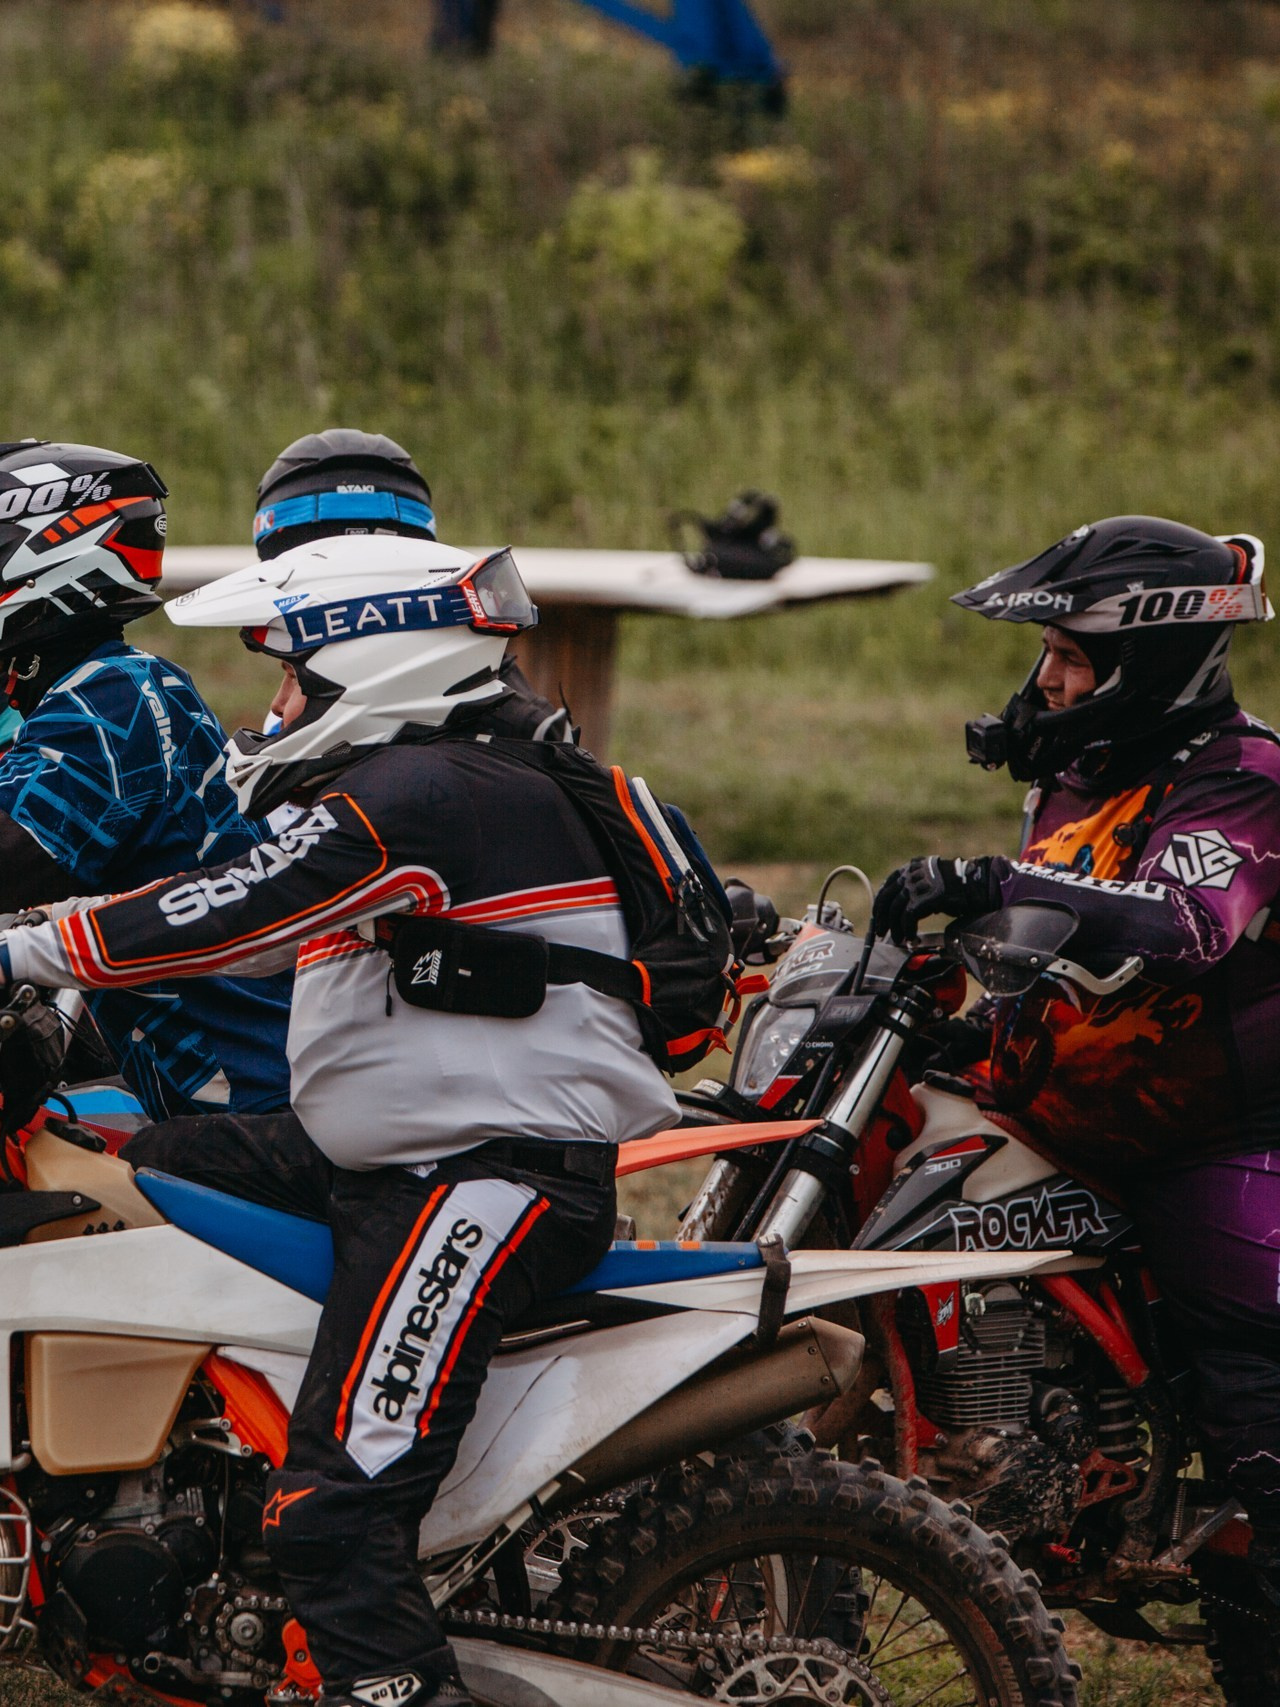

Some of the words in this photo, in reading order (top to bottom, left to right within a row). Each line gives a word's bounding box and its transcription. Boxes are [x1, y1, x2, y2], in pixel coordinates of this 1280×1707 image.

[296, 594, 443, 643] LEATT
[463, 586, 486, 619] LEATT
[983, 591, 1074, 612] AIROH
[1119, 584, 1244, 626] 100%
[924, 1158, 962, 1176] 300
[948, 1187, 1109, 1252] ROCKER
[370, 1218, 484, 1422] alpinestars
